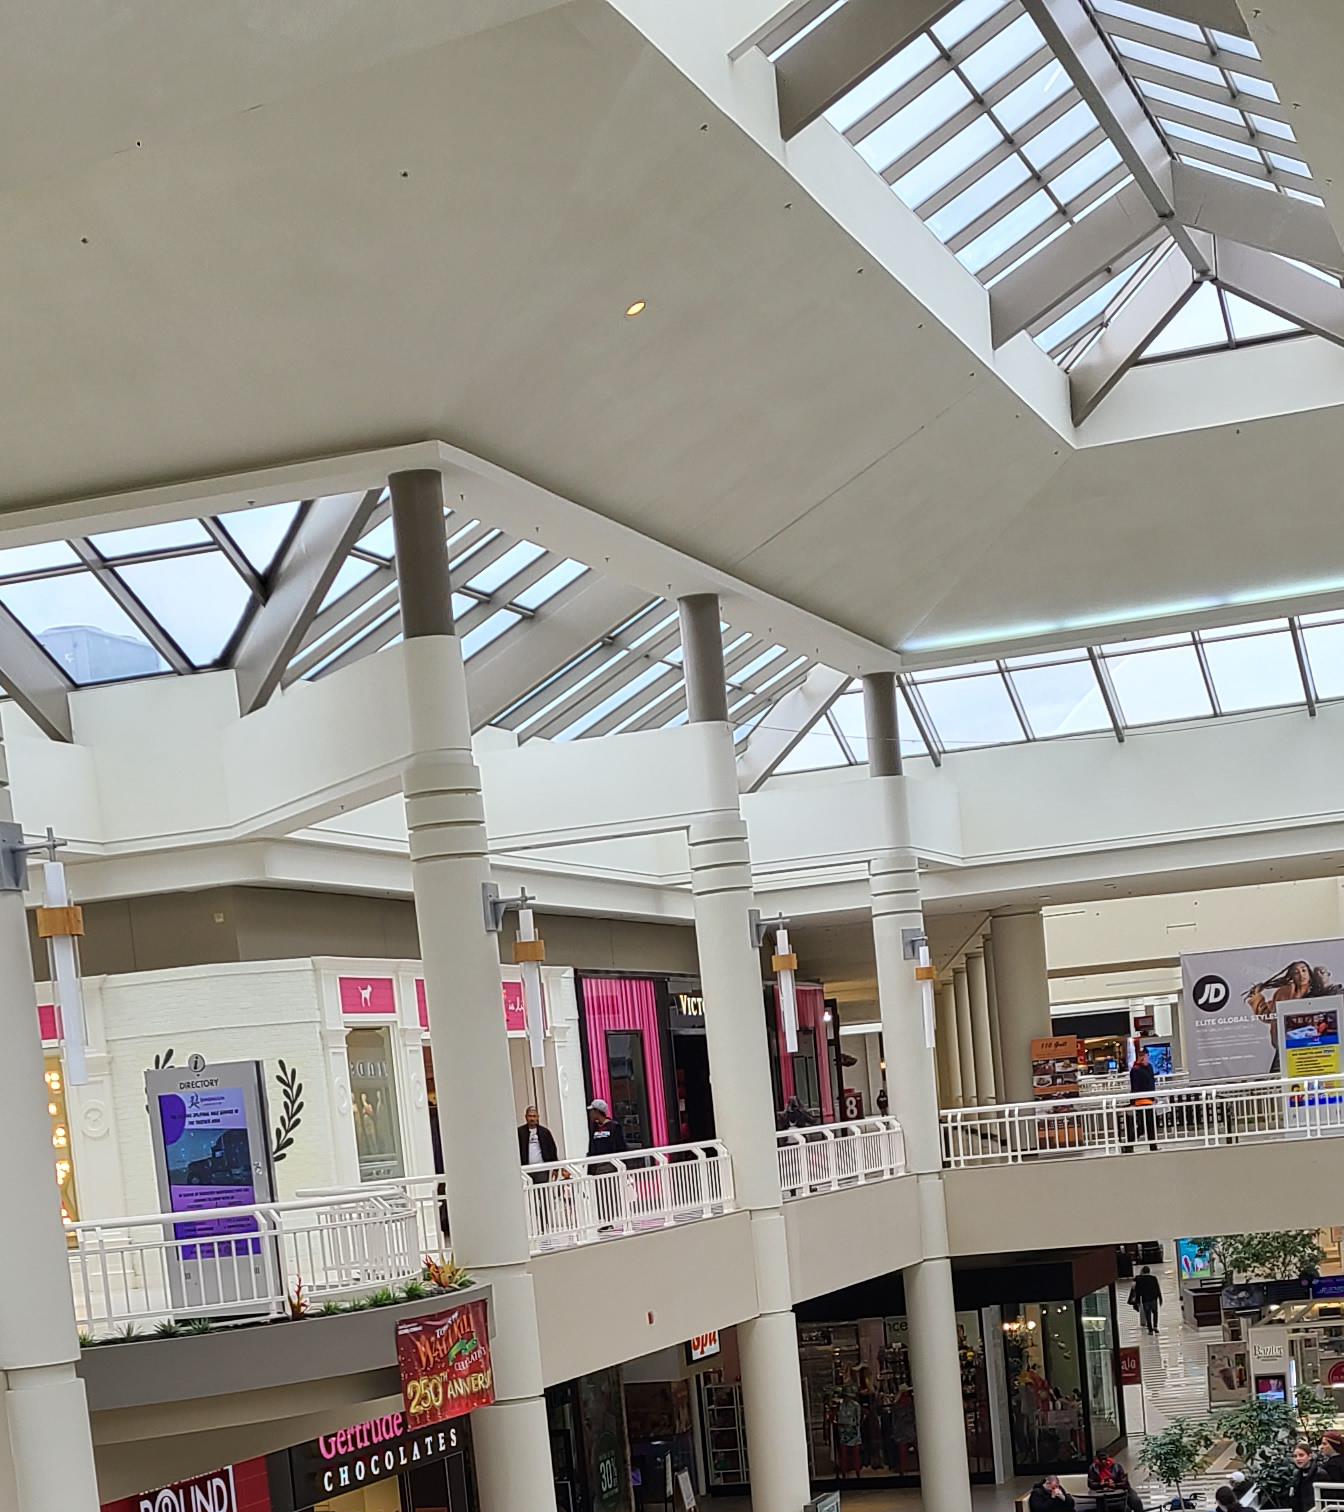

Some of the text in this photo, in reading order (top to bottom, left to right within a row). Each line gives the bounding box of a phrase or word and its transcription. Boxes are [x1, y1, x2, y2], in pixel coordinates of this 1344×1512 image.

[679, 994, 705, 1016] VICT
[1198, 983, 1226, 1005] JD
[179, 1079, 219, 1090] DIRECTORY
[319, 1411, 404, 1460] Gertrude
[323, 1427, 458, 1492] CHOCOLATES
